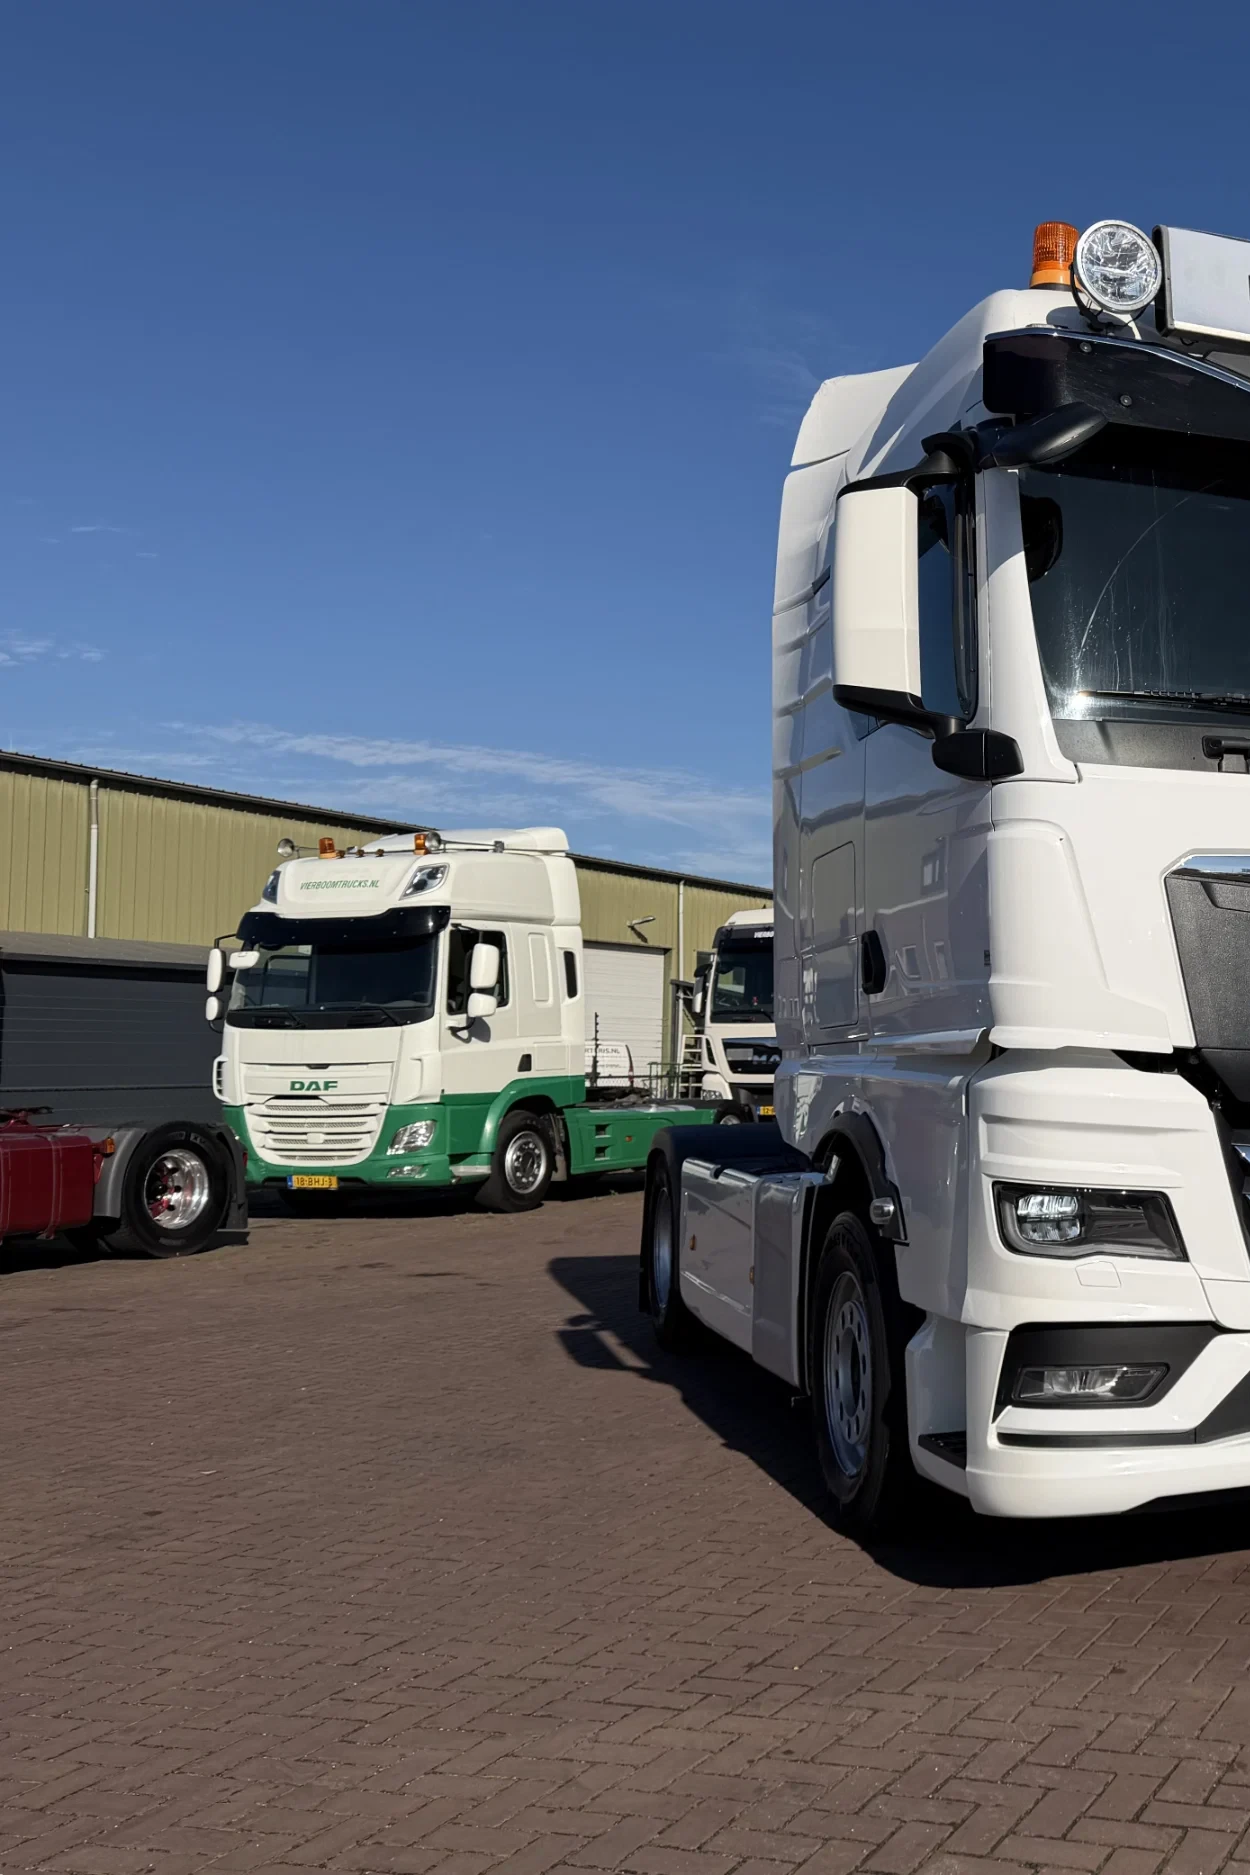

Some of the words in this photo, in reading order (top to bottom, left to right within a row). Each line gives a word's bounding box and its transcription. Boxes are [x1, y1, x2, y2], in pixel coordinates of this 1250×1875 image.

[300, 880, 380, 890] VIERBOOMTRUCKS.NL
[752, 1054, 781, 1065] MA
[290, 1080, 338, 1091] DAF
